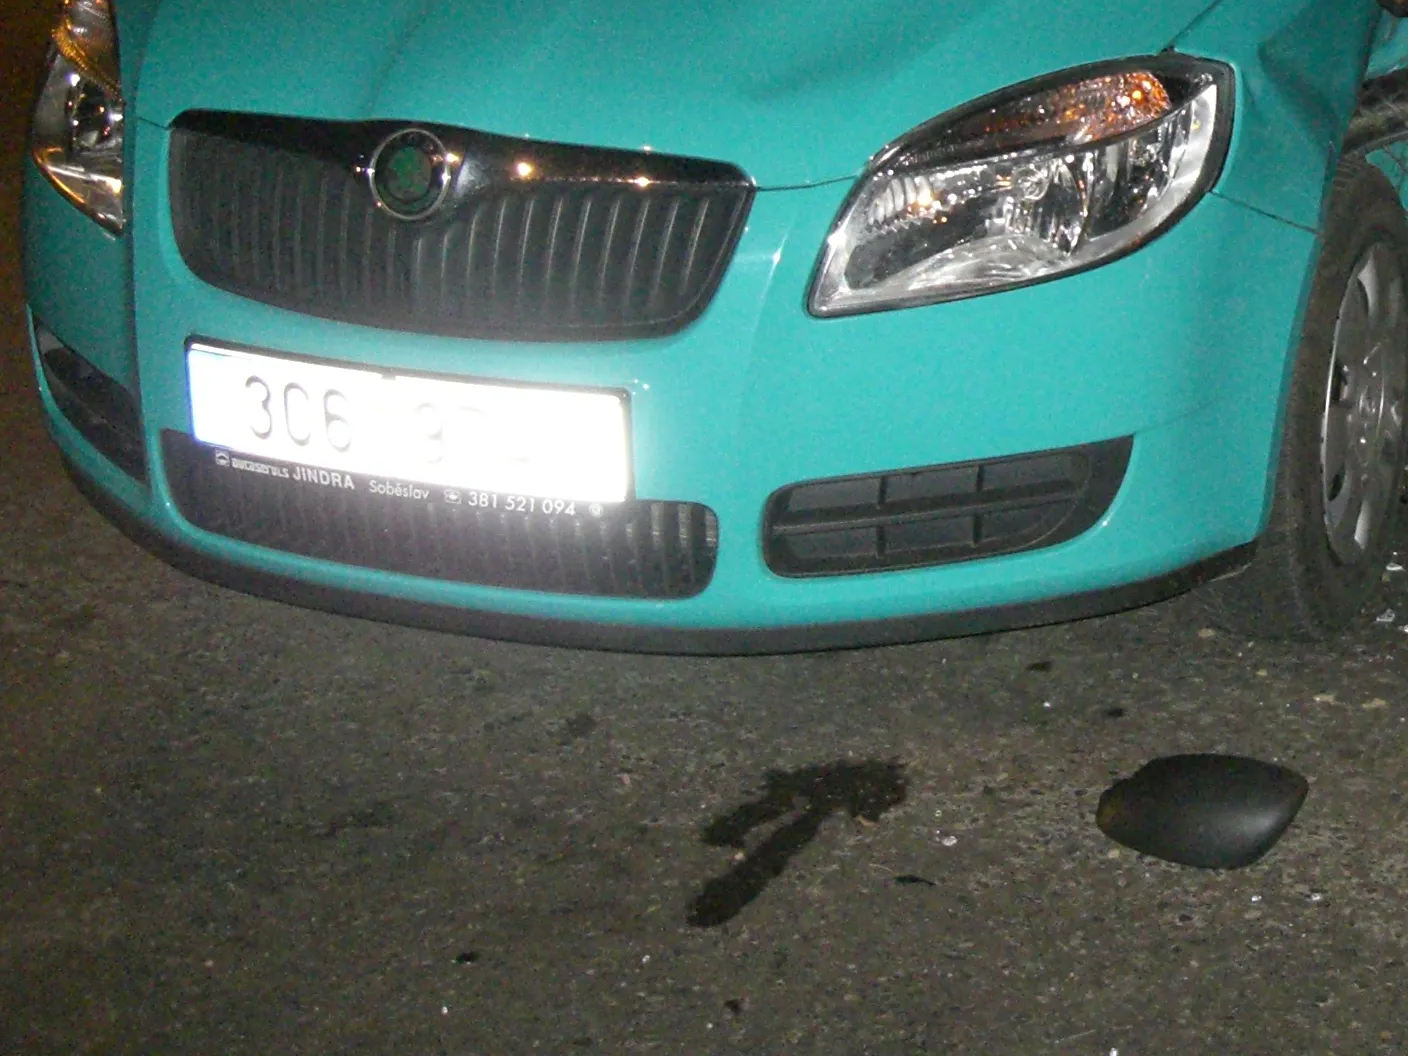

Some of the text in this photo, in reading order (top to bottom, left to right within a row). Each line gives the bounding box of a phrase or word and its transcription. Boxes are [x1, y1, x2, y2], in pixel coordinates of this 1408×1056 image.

[292, 465, 356, 490] JINDRA
[368, 479, 430, 500] Soběslav
[467, 491, 498, 508] 381
[504, 495, 536, 512] 521
[541, 499, 576, 516] 094
